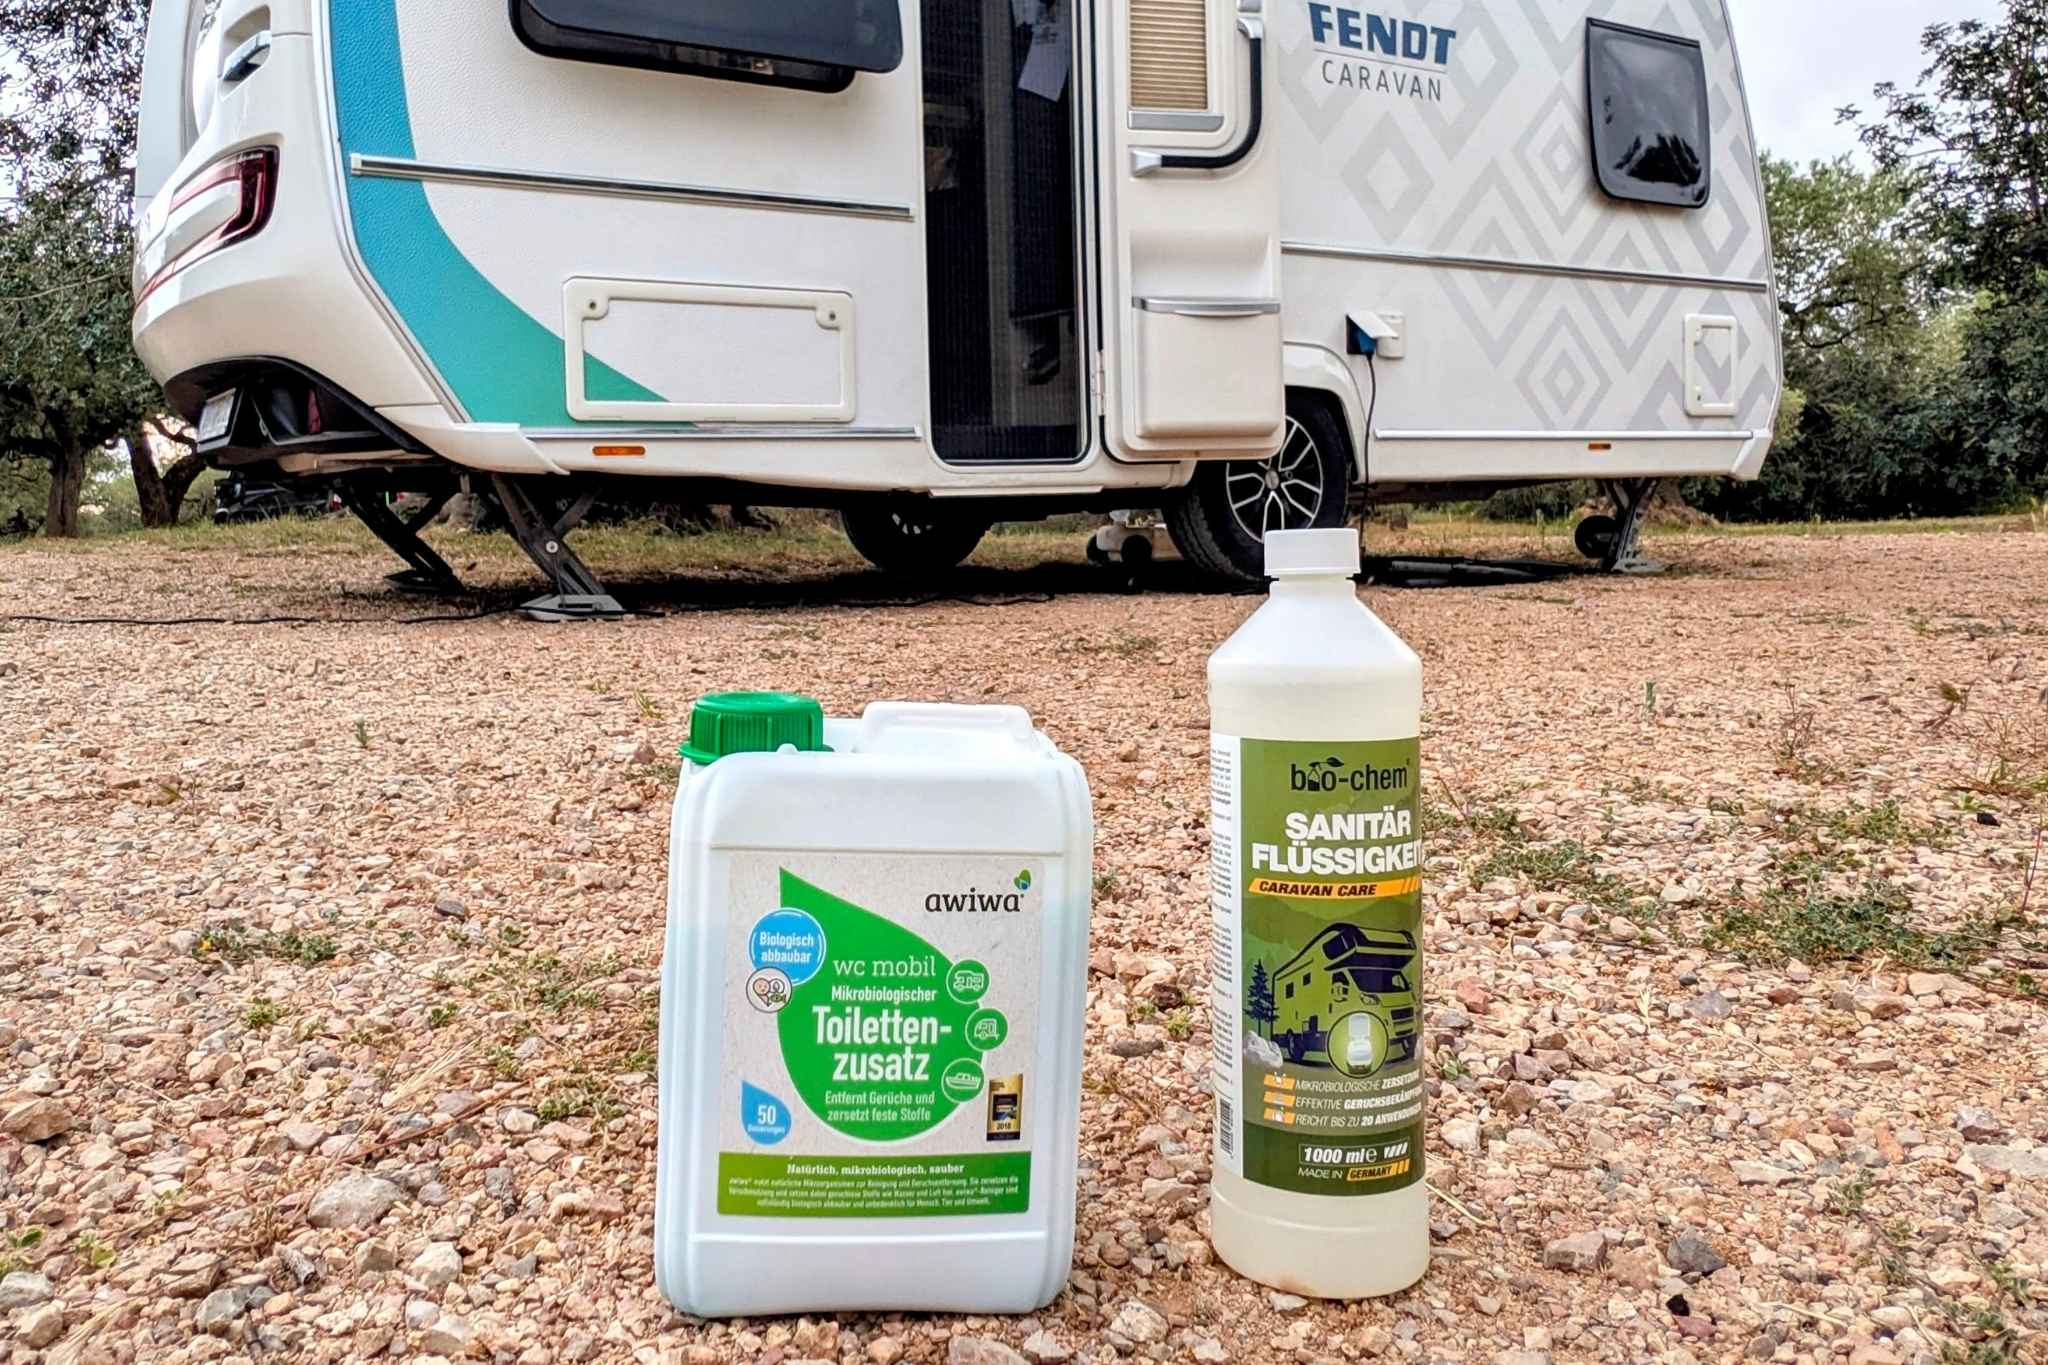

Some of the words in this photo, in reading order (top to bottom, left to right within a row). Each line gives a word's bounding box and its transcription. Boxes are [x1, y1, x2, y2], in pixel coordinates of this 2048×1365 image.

[1308, 2, 1456, 65] FENDT
[1322, 60, 1441, 102] CARAVAN
[1285, 805, 1411, 841] SANITÄR
[1259, 881, 1333, 897] CARAVAN
[1337, 884, 1377, 897] CARE
[925, 887, 1021, 912] awiwa
[759, 931, 814, 949] Biologisch
[761, 948, 812, 963] abbaubar
[832, 960, 866, 976] wc
[872, 955, 936, 976] mobil
[831, 985, 937, 1005] Mikrobiologischer
[812, 1005, 952, 1045] Toiletten-
[832, 1045, 930, 1081] zusatz
[1295, 1079, 1381, 1093] MIKROBIOLOGISCHE
[825, 1090, 867, 1104] Entfernt
[869, 1091, 912, 1104] Gerüche
[915, 1090, 935, 1104] und
[1295, 1097, 1342, 1110] EFFEKTIVE
[757, 1104, 777, 1125] 50
[827, 1108, 870, 1121] zersetzt
[871, 1107, 898, 1121] feste
[900, 1107, 931, 1121] Stoffe
[1295, 1113, 1330, 1127] REICHT
[1330, 1116, 1346, 1127] BIS
[1347, 1116, 1360, 1127] ZU
[1361, 1116, 1374, 1126] 20
[1304, 1147, 1342, 1163] 1000
[787, 1164, 839, 1176] Natürlich,
[841, 1164, 927, 1177] mikrobiologisch,
[929, 1163, 964, 1174] sauber
[1298, 1167, 1329, 1179] MADE
[1331, 1169, 1343, 1179] IN
[1350, 1166, 1392, 1179] GERMANY
